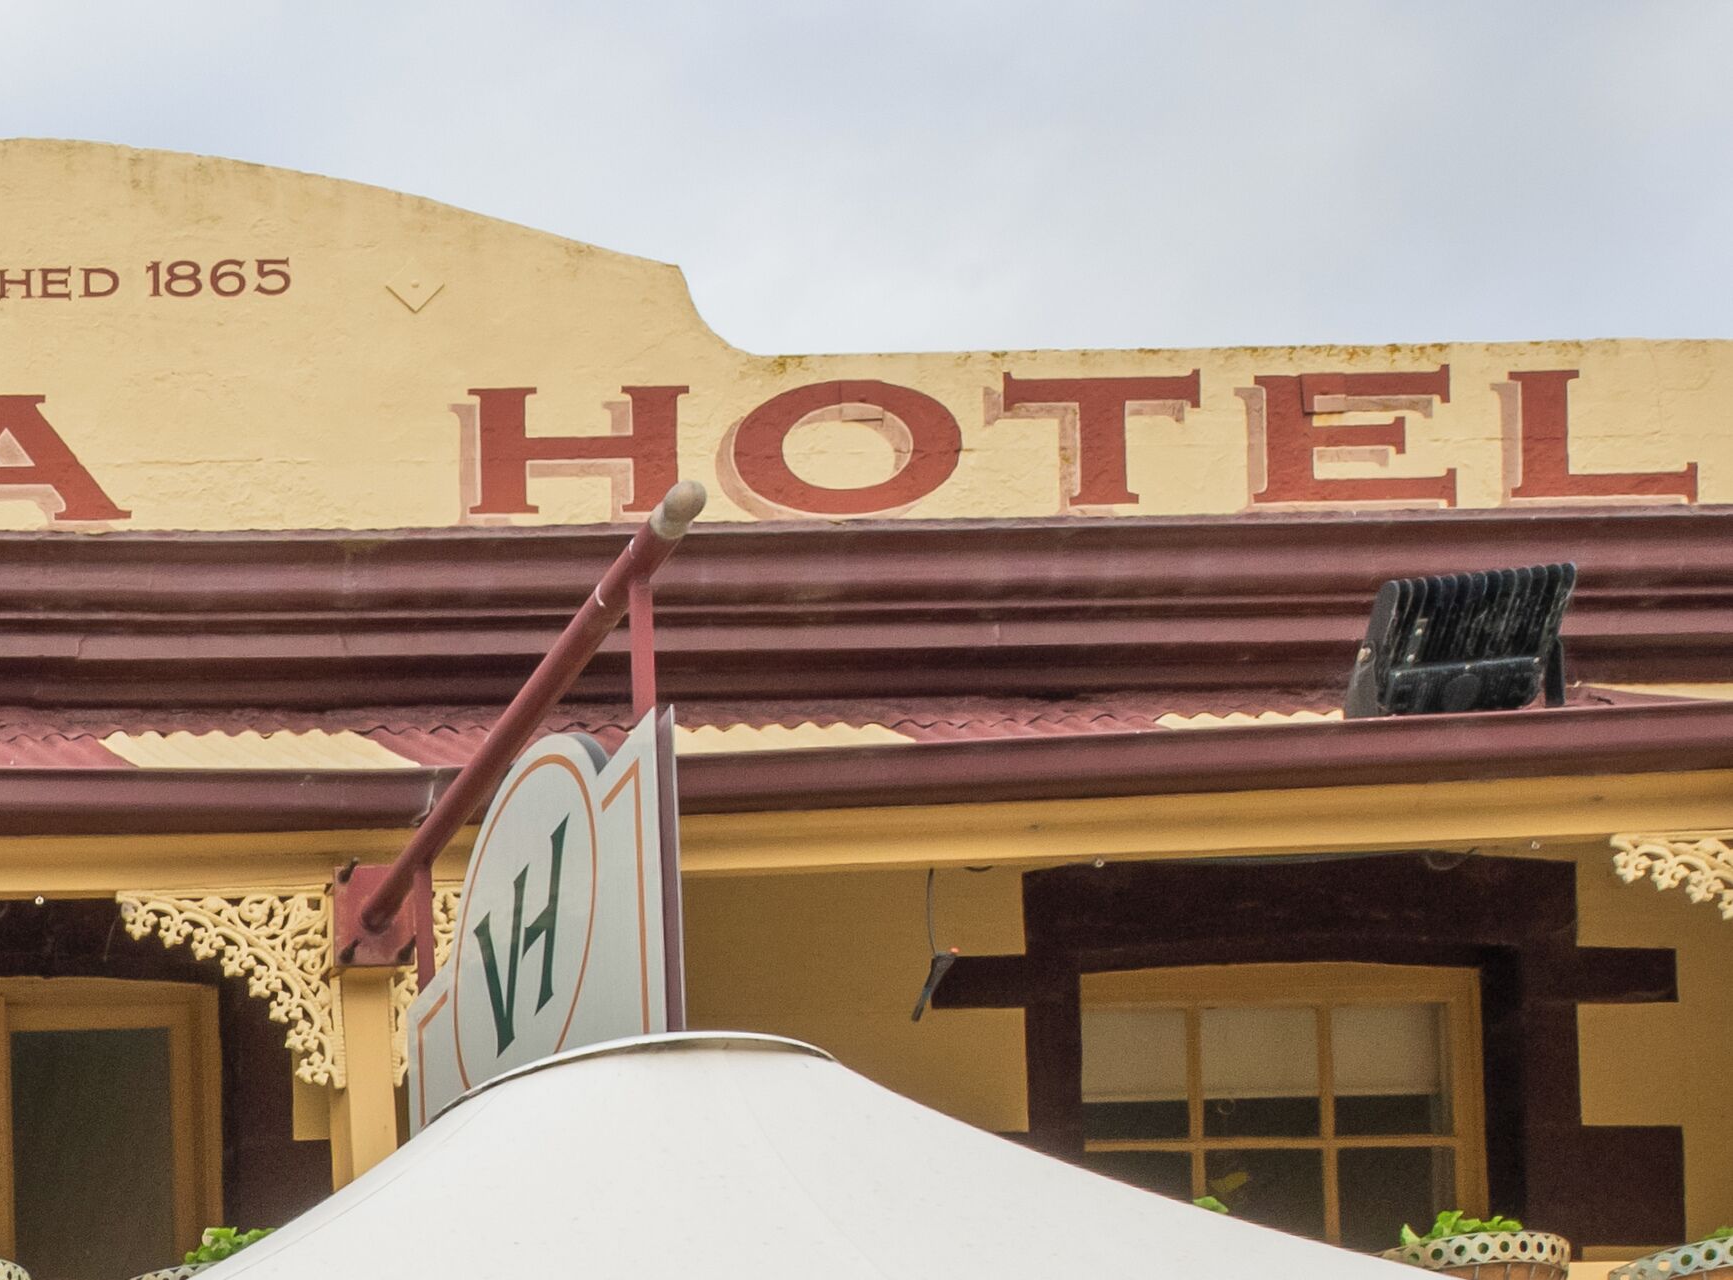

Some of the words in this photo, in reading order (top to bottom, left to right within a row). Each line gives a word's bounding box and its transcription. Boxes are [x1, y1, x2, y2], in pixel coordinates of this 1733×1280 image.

[146, 256, 293, 298] 1865
[458, 364, 1699, 518] HOTEL
[472, 811, 570, 1058] VH
